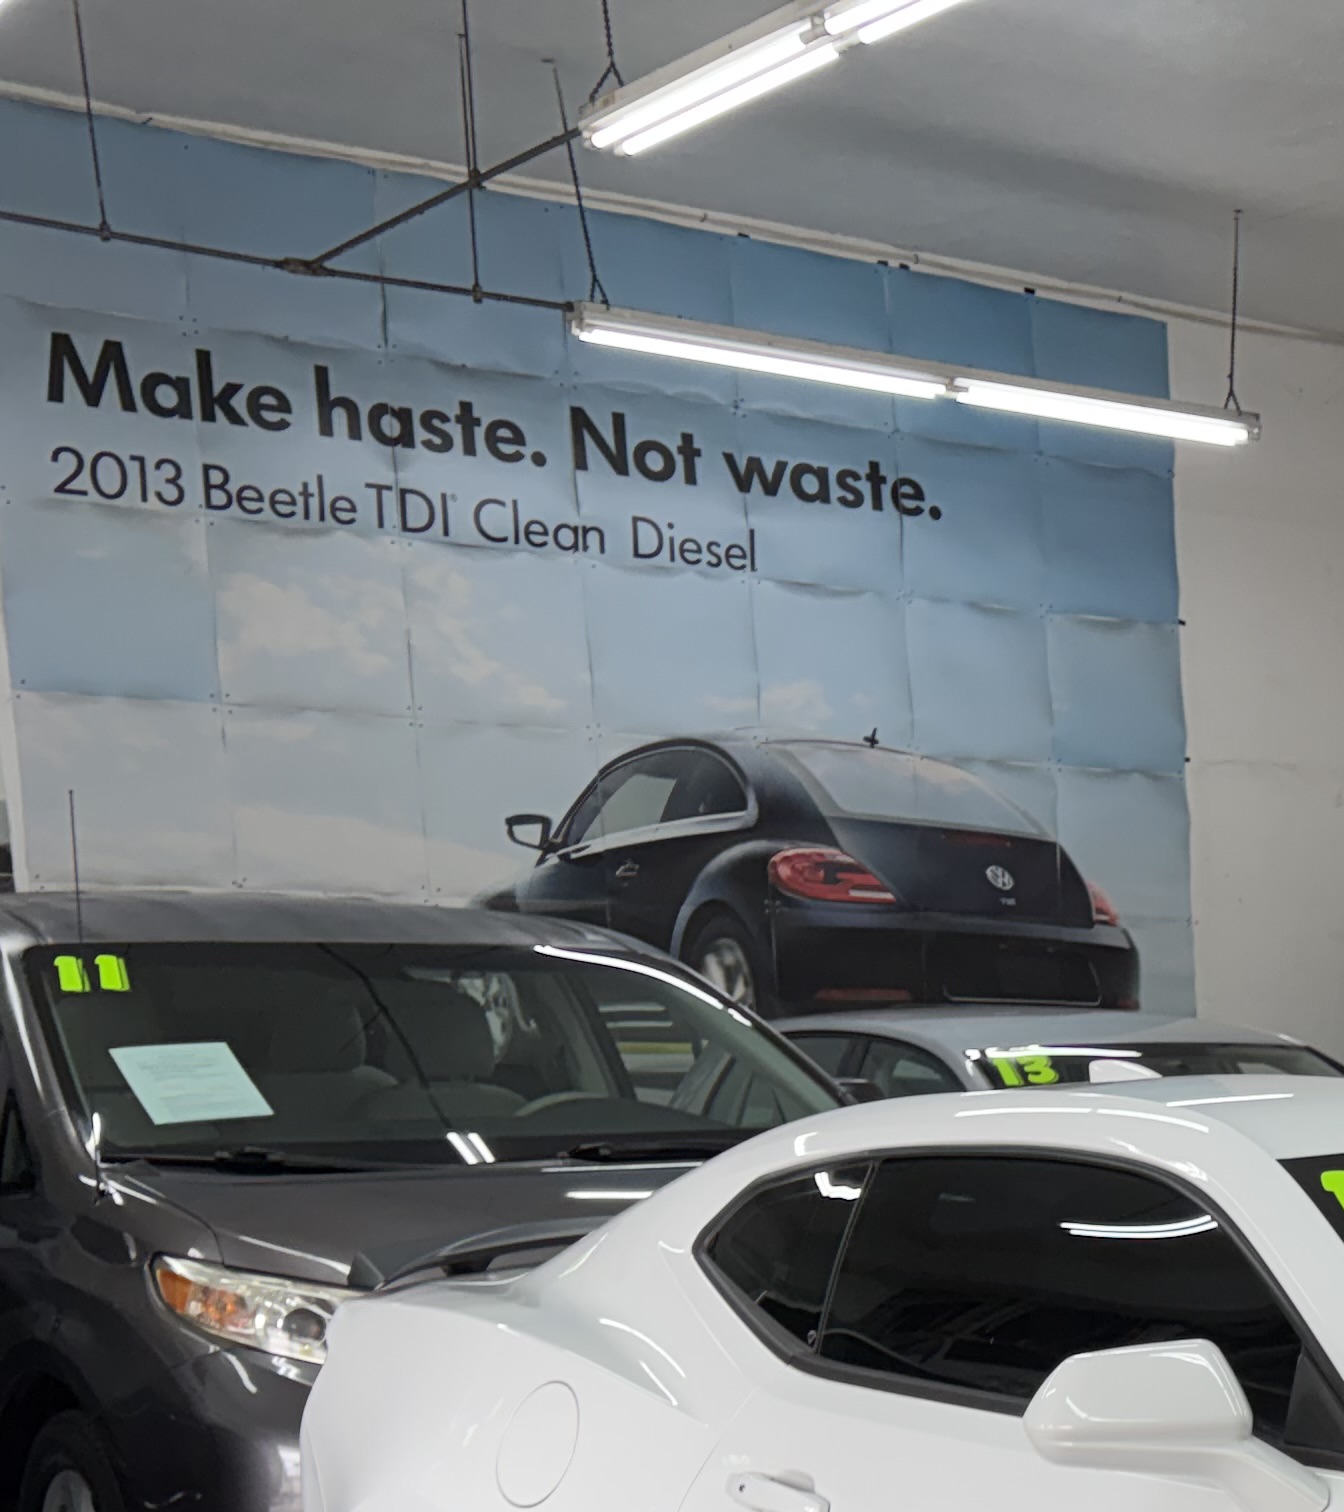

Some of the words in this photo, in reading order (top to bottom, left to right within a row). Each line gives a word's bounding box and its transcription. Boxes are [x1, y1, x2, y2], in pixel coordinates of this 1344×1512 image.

[47, 332, 293, 433] Make
[313, 364, 548, 468] haste.
[570, 405, 703, 486] Not
[723, 451, 943, 521] waste.
[50, 446, 186, 507] 2013
[202, 463, 357, 525] Beetle
[473, 498, 606, 555] Clean
[631, 515, 759, 573] Diesel
[53, 954, 132, 993] 11
